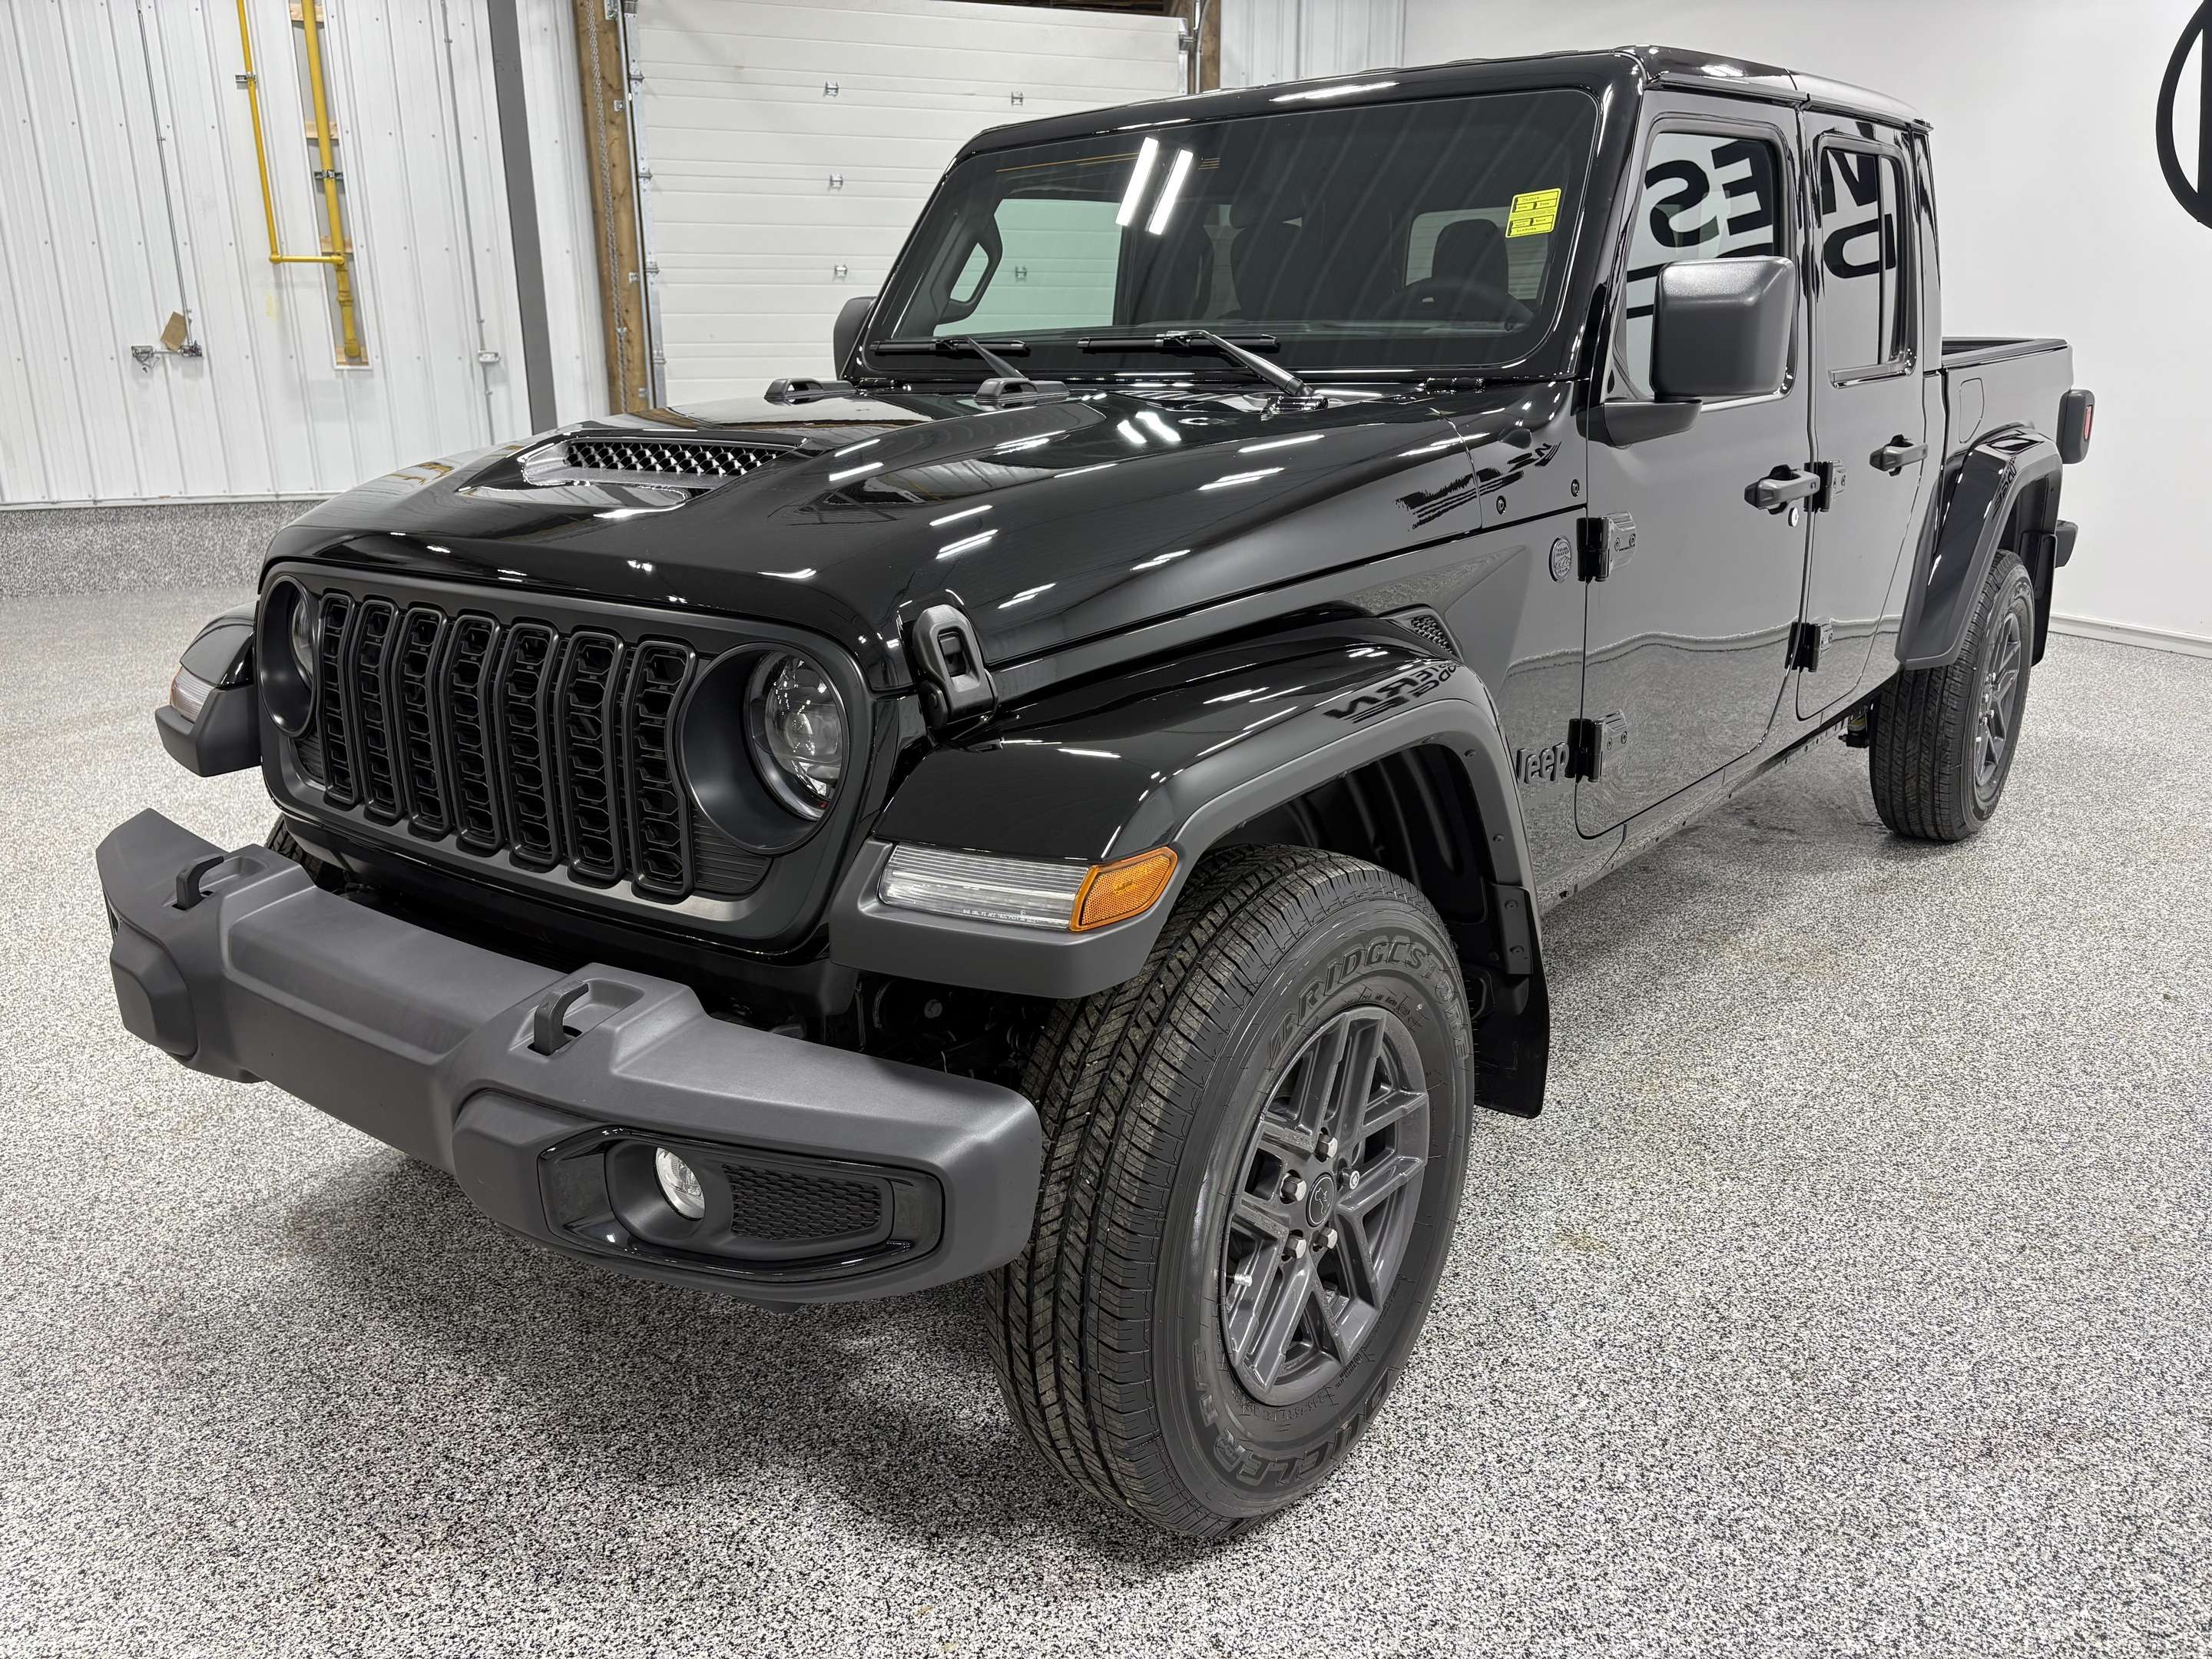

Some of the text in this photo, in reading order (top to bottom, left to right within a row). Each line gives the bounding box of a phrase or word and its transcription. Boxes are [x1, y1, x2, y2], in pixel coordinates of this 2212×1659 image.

[1515, 741, 1570, 783] Jeep
[1269, 934, 1469, 1066] BRIDGESTONE
[1214, 1367, 1389, 1488] DUELER
